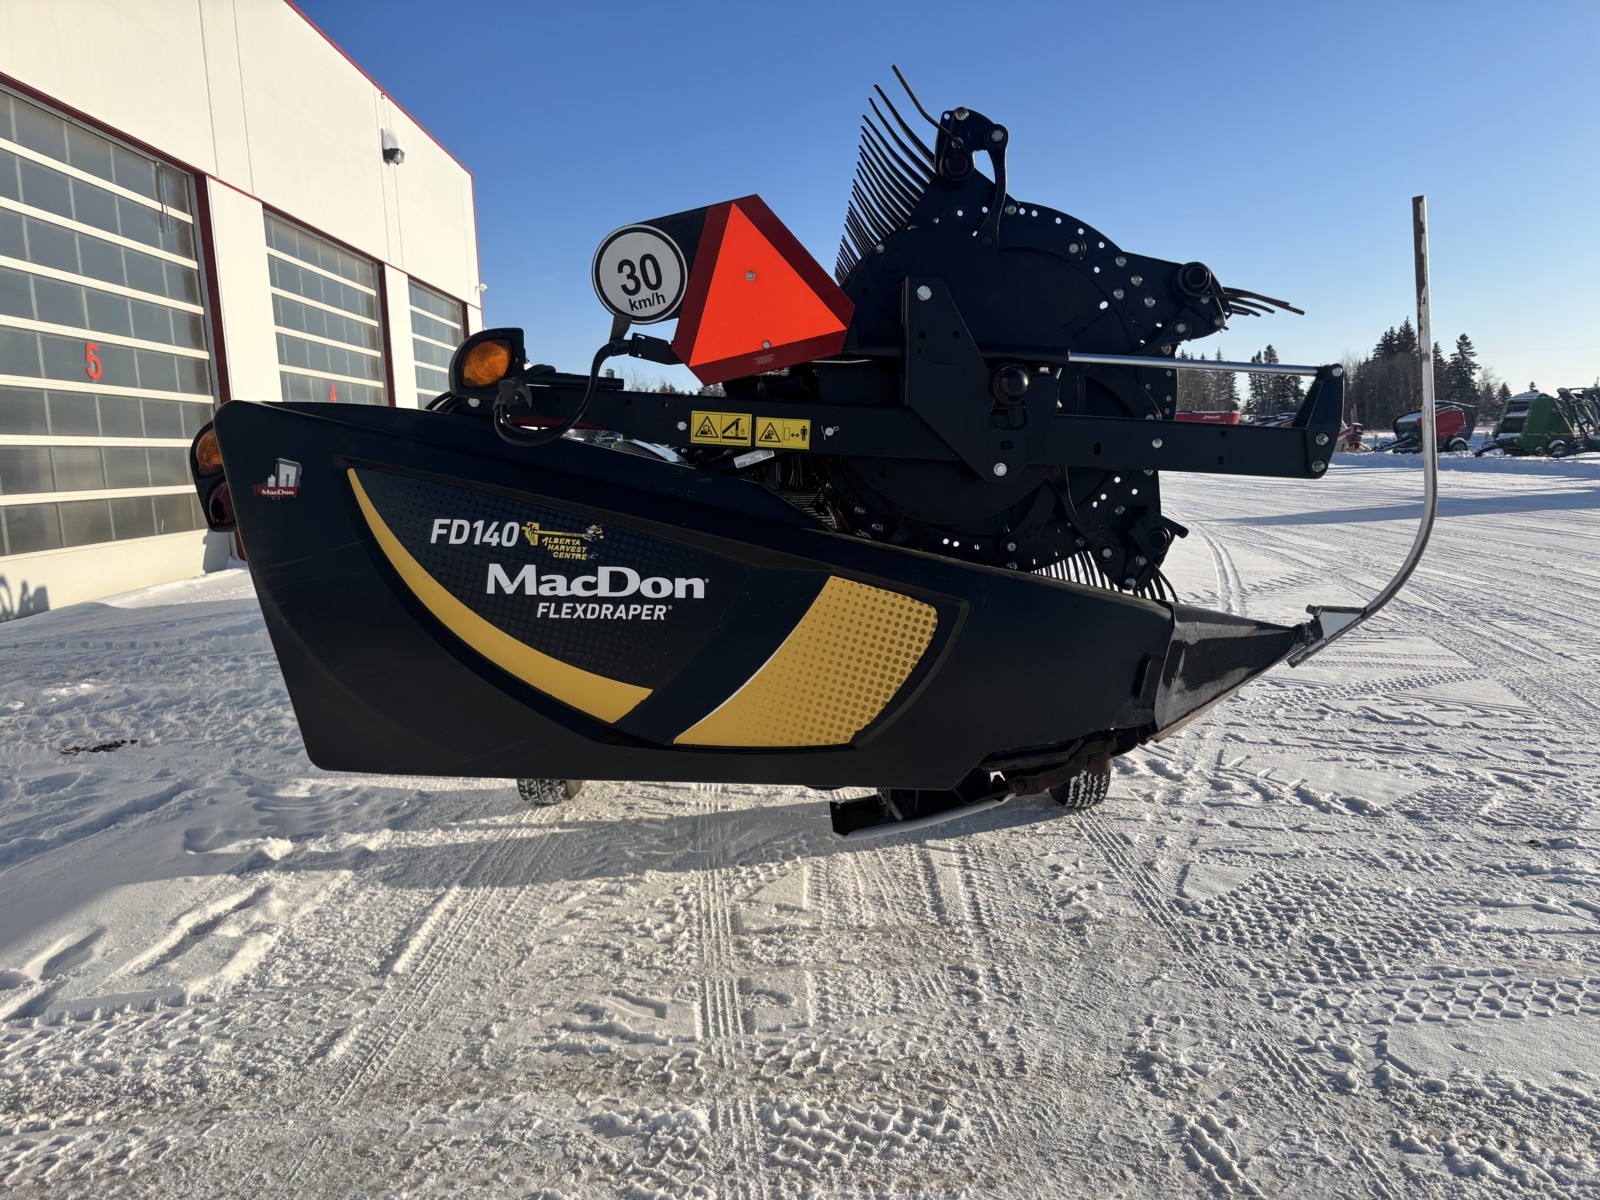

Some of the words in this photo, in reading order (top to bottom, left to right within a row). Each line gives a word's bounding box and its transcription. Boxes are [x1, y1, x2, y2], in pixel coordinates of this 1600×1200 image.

[617, 253, 663, 296] 30
[628, 292, 667, 311] km/h
[85, 341, 102, 380] 5
[329, 382, 337, 403] 4
[430, 519, 520, 547] FD140
[541, 536, 581, 546] ALBERTA
[547, 544, 588, 553] HARVEST
[552, 551, 588, 560] CENTRE
